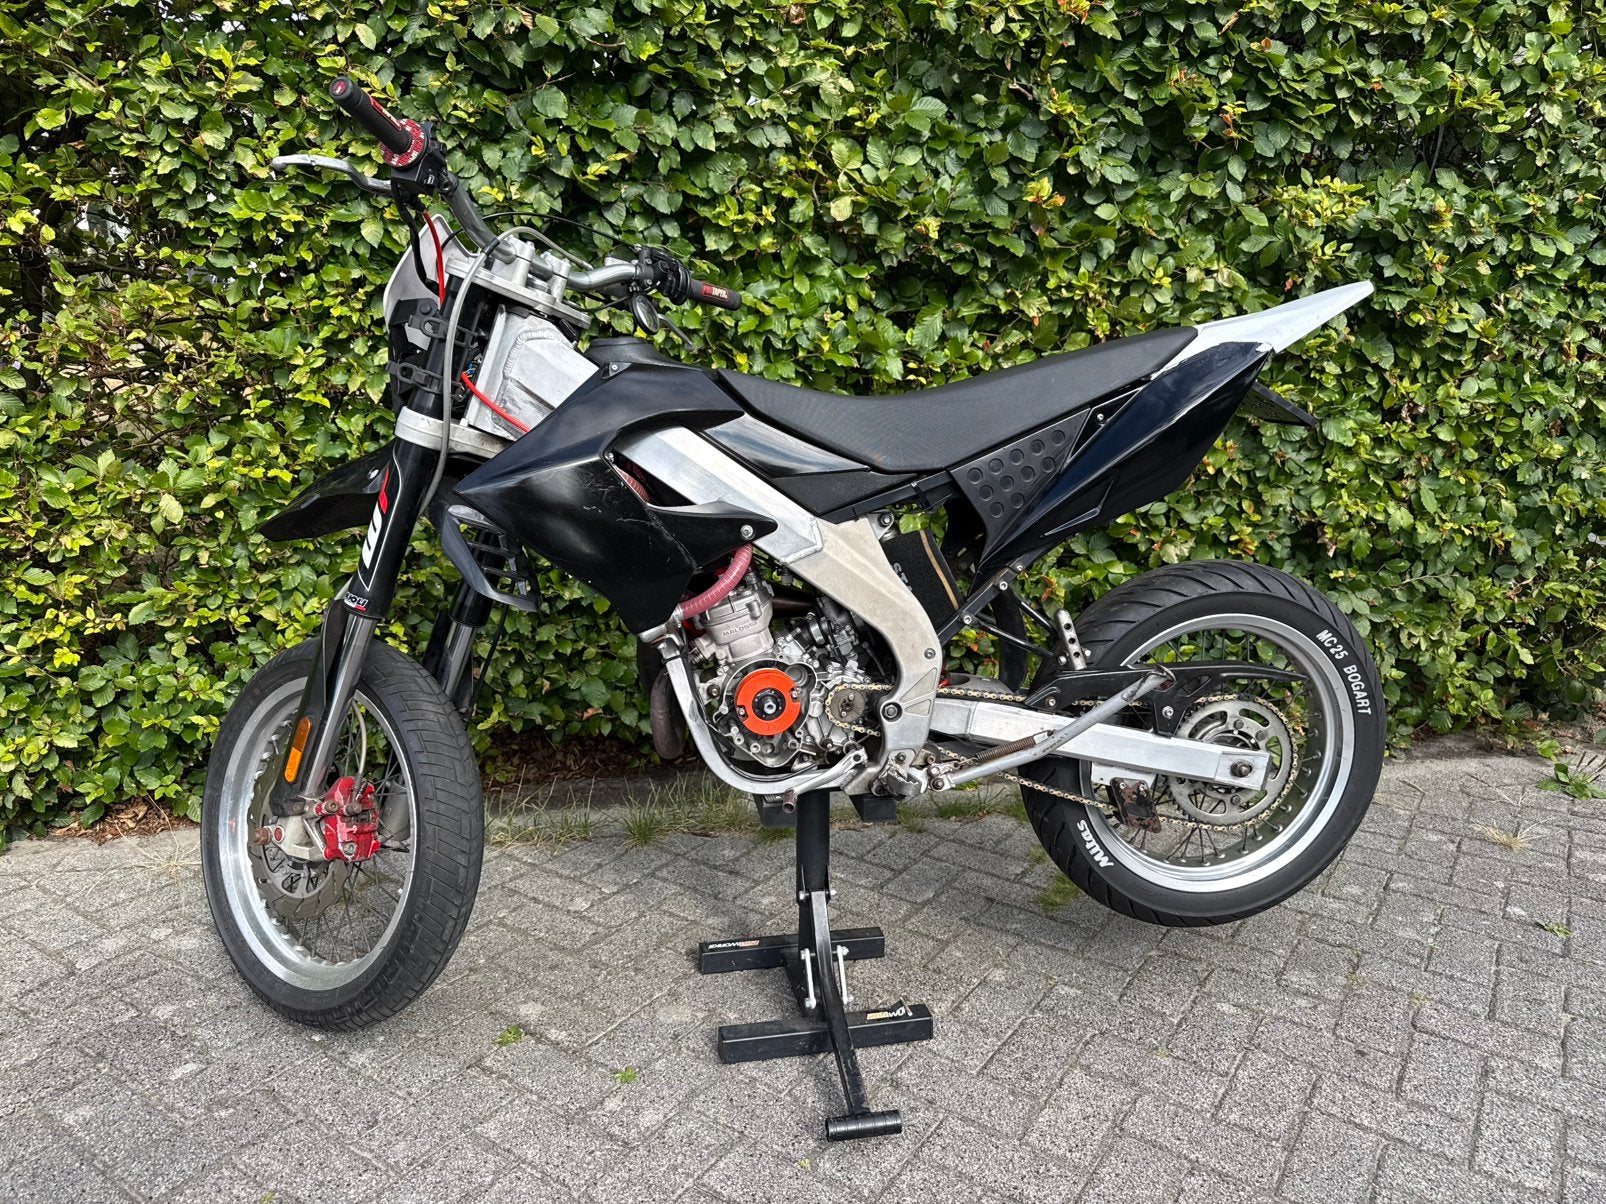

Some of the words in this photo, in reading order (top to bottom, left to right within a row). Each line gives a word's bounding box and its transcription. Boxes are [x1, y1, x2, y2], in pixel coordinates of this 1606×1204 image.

[1316, 629, 1349, 660] MC25
[1343, 664, 1372, 715] BOGART
[1076, 819, 1115, 868] Mitas
